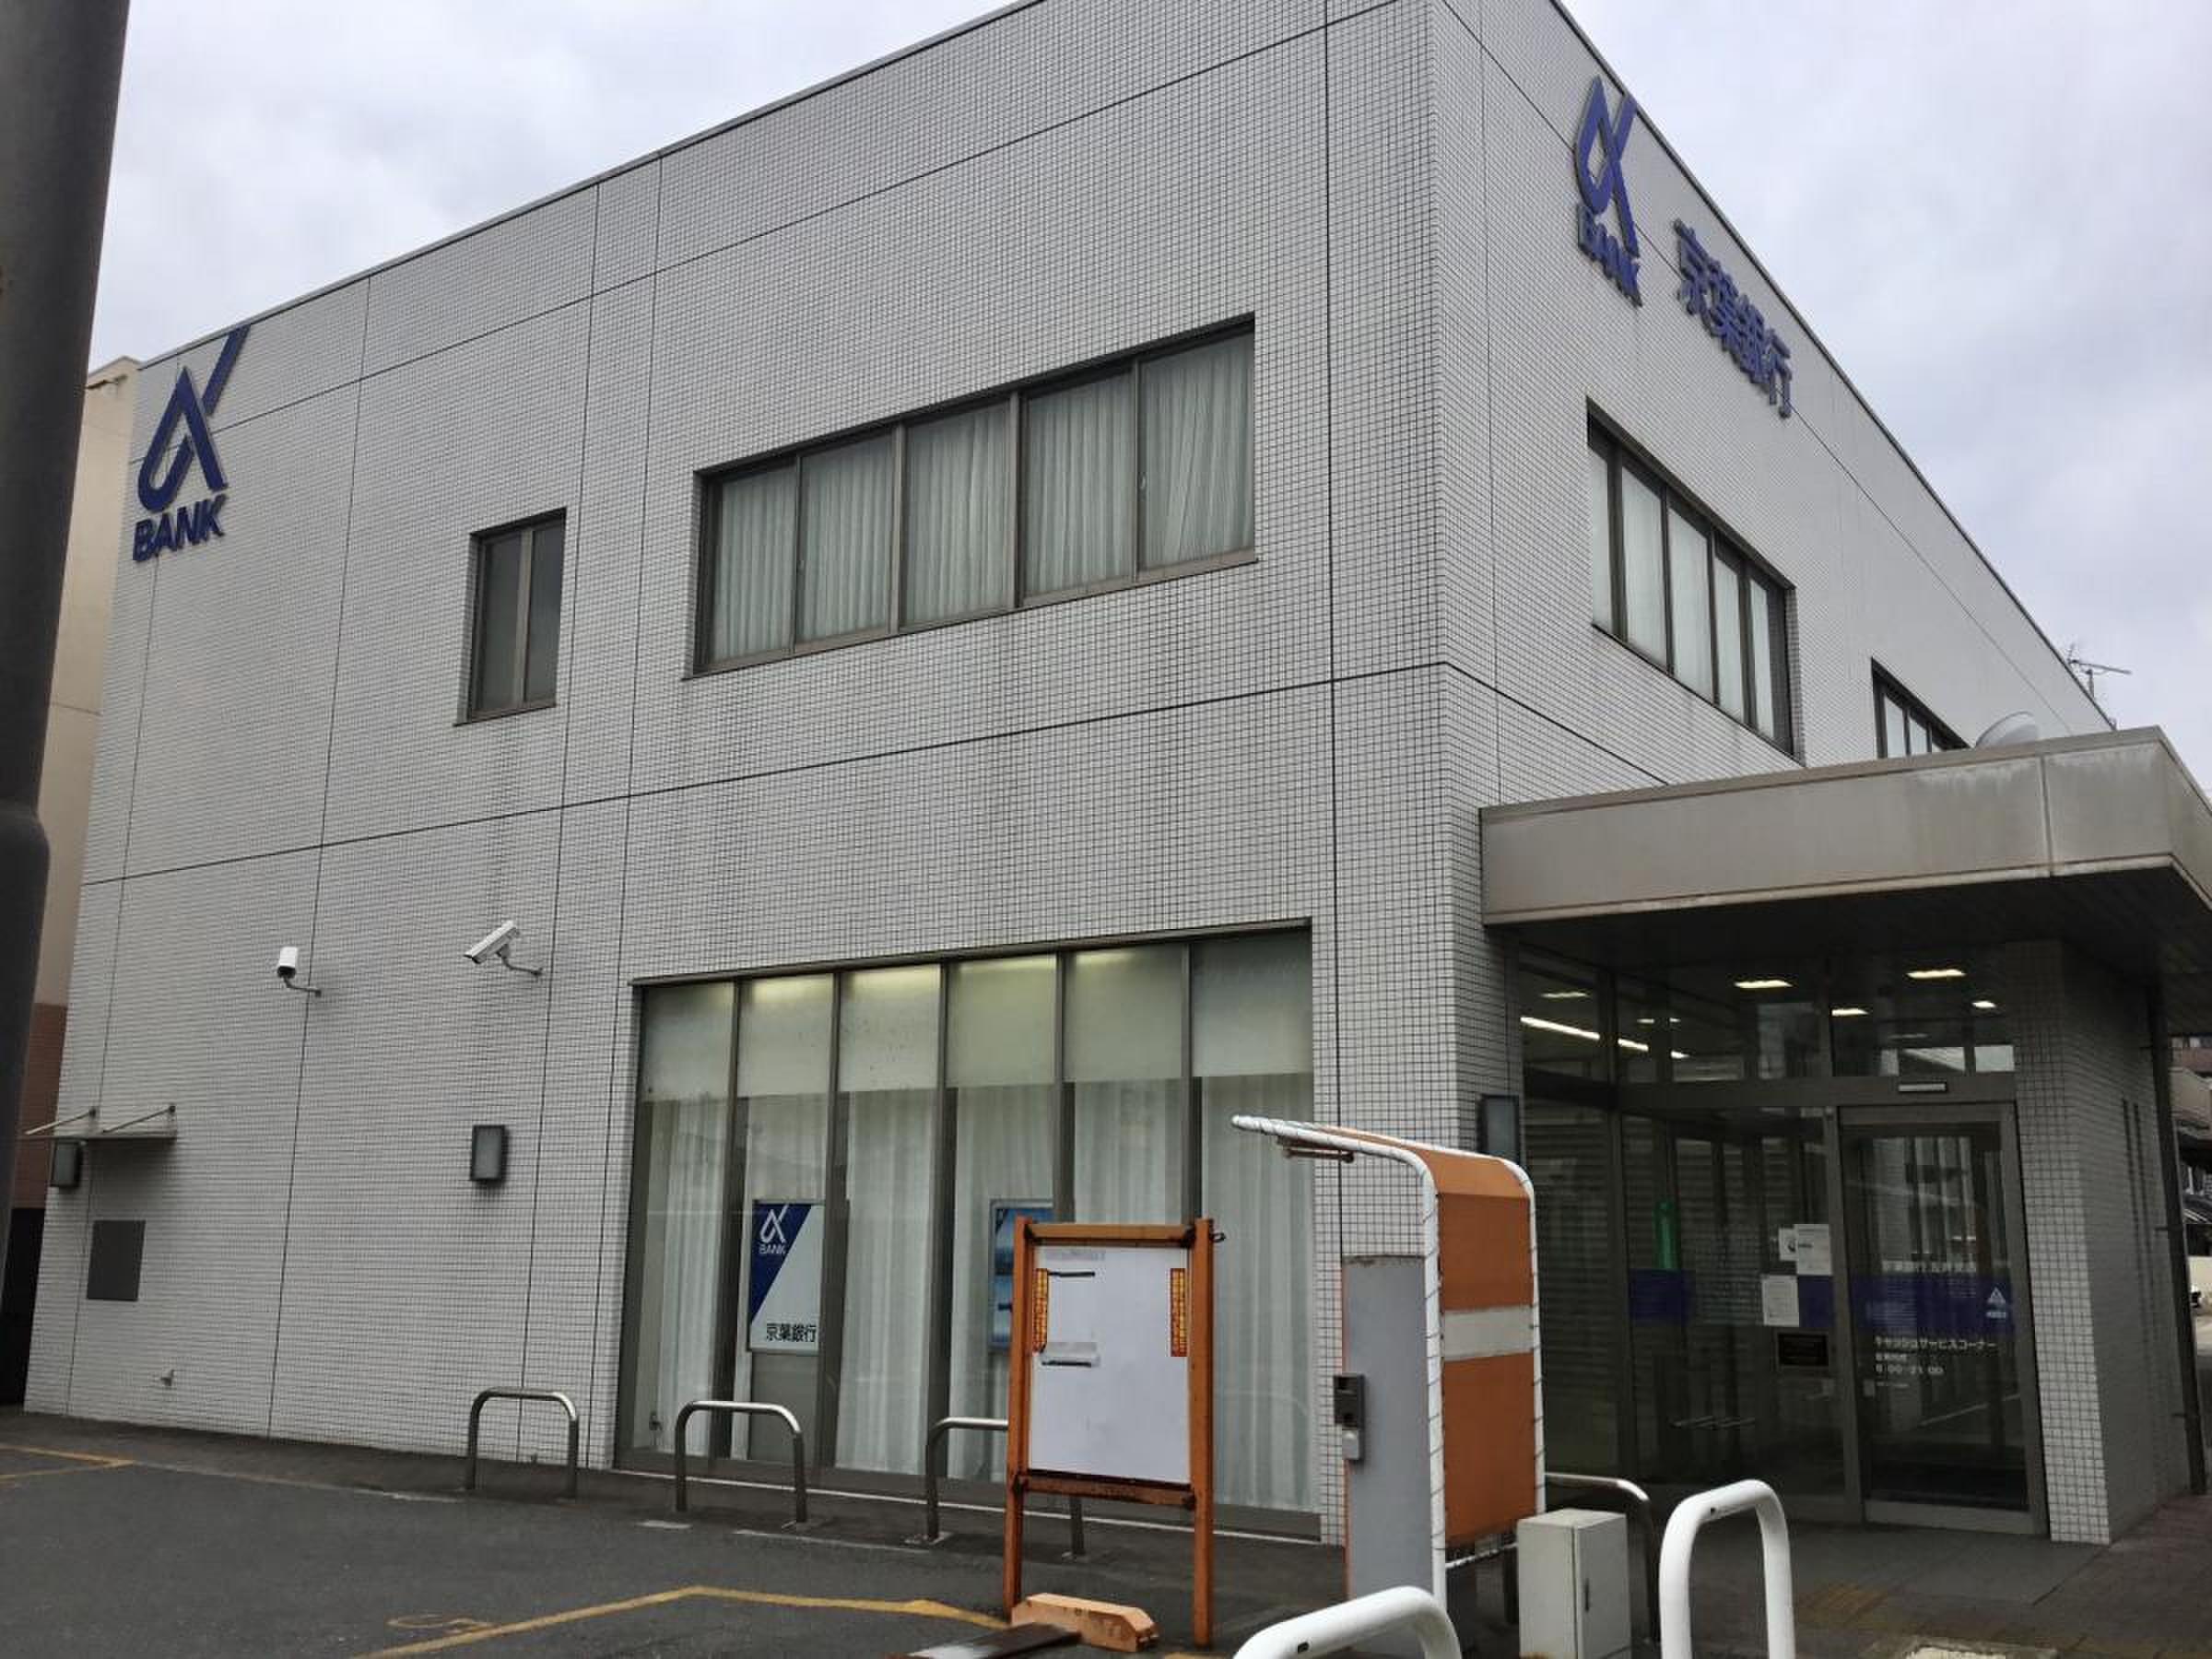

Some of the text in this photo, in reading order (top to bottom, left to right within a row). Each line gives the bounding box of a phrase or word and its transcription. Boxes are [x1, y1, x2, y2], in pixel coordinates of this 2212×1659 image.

[1674, 218, 1794, 419] 京葉銀行
[132, 492, 229, 563] BANK
[759, 1244, 786, 1254] BANK
[766, 1323, 817, 1343] 京葉銀行
